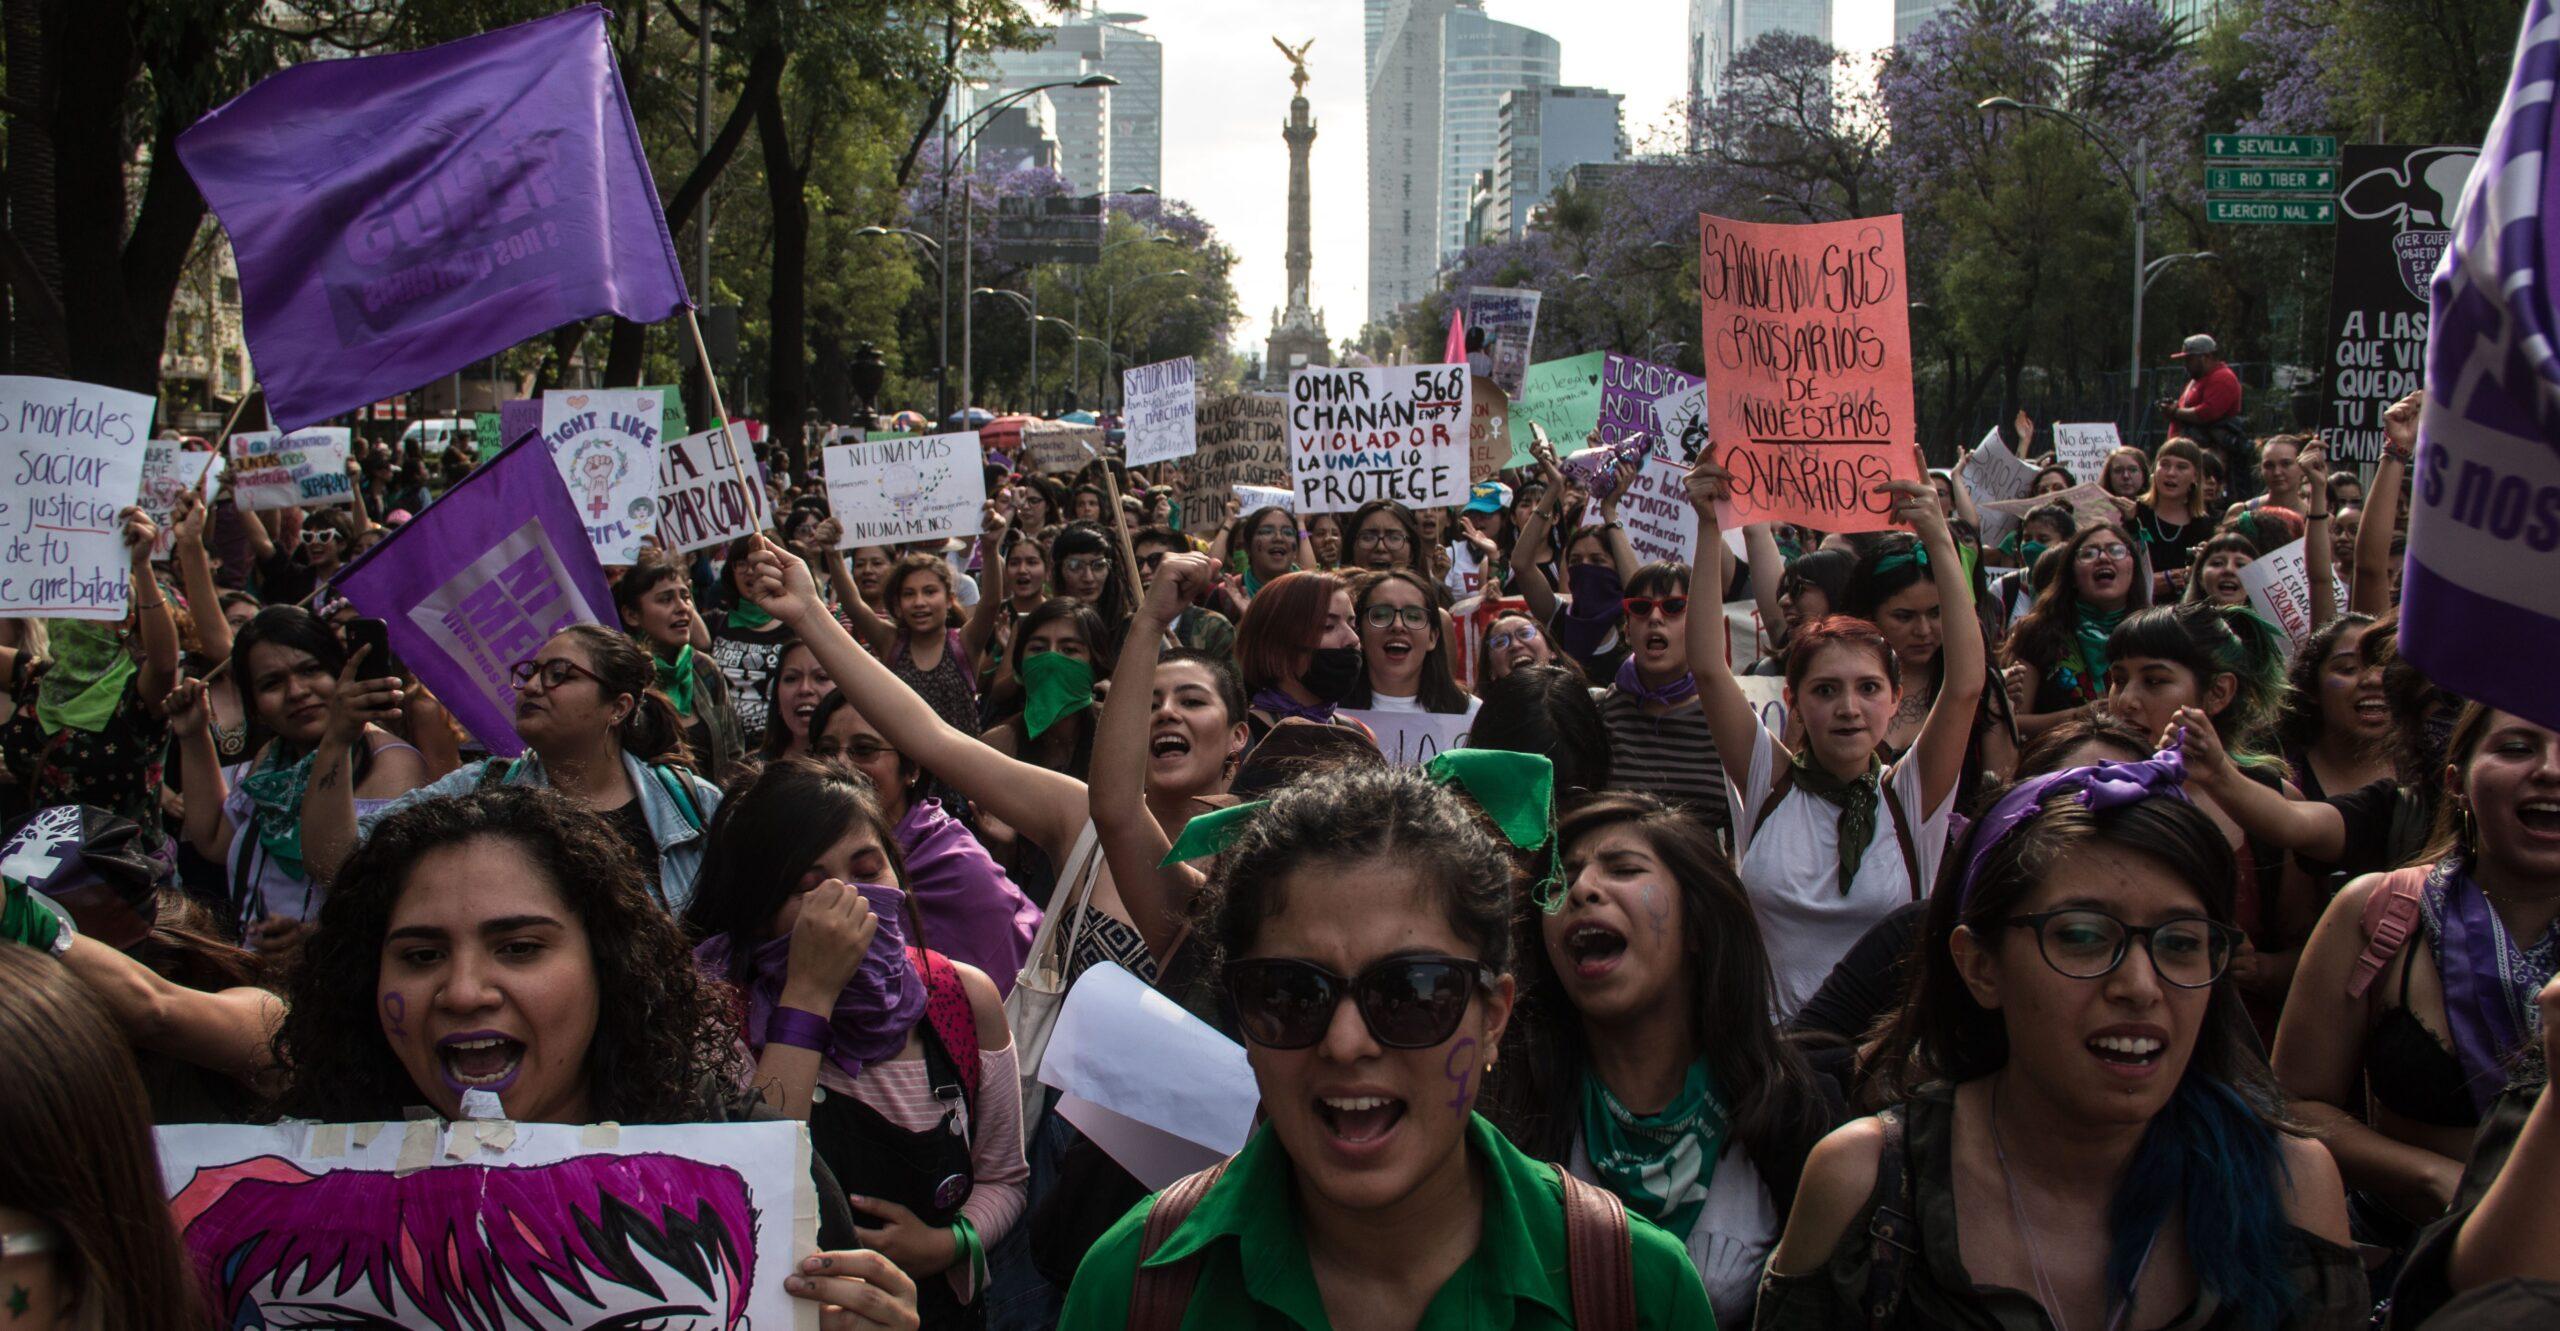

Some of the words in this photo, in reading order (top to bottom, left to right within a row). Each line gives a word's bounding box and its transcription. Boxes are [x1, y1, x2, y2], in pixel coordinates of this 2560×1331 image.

[2237, 140, 2299, 153] SEVILLA
[2240, 172, 2263, 187] RIO
[2269, 172, 2308, 187] TIBER
[2217, 203, 2277, 219] EJERCITO
[2283, 204, 2310, 219] NAL
[2396, 234, 2420, 247] VER
[2401, 247, 2436, 260] OBJETO
[1704, 223, 1798, 313] SAQUEN
[1823, 244, 1887, 313] SUS
[2342, 310, 2365, 338] A
[2378, 311, 2427, 341] LAS
[1733, 315, 1884, 373] ROSARIOS
[2335, 340, 2385, 368] QUE
[2394, 342, 2427, 369] VI
[1166, 358, 1193, 387] MOON
[1295, 371, 1370, 404] OMAR
[1412, 367, 1464, 402] 568
[1787, 378, 1821, 401] DE
[19, 397, 135, 445] mortales
[1294, 392, 1416, 432] CHANÁN
[1605, 393, 1632, 422] NO
[1744, 400, 1891, 439] NUESTROS
[2333, 400, 2365, 427] TU
[545, 411, 598, 453] FIGHT
[610, 411, 658, 448] LIKE
[1300, 424, 1450, 453] VIOLADOR
[2059, 429, 2076, 446] No
[873, 441, 904, 463] UNA
[909, 437, 951, 460] MAS
[1263, 445, 1282, 462] LA
[1325, 450, 1393, 471] UNAM
[15, 450, 110, 488] saciar
[1725, 445, 1894, 514] OVARIOS
[1302, 466, 1450, 508] PROTEGE
[1622, 491, 1678, 519] JUNTAS
[6, 535, 33, 563] de
